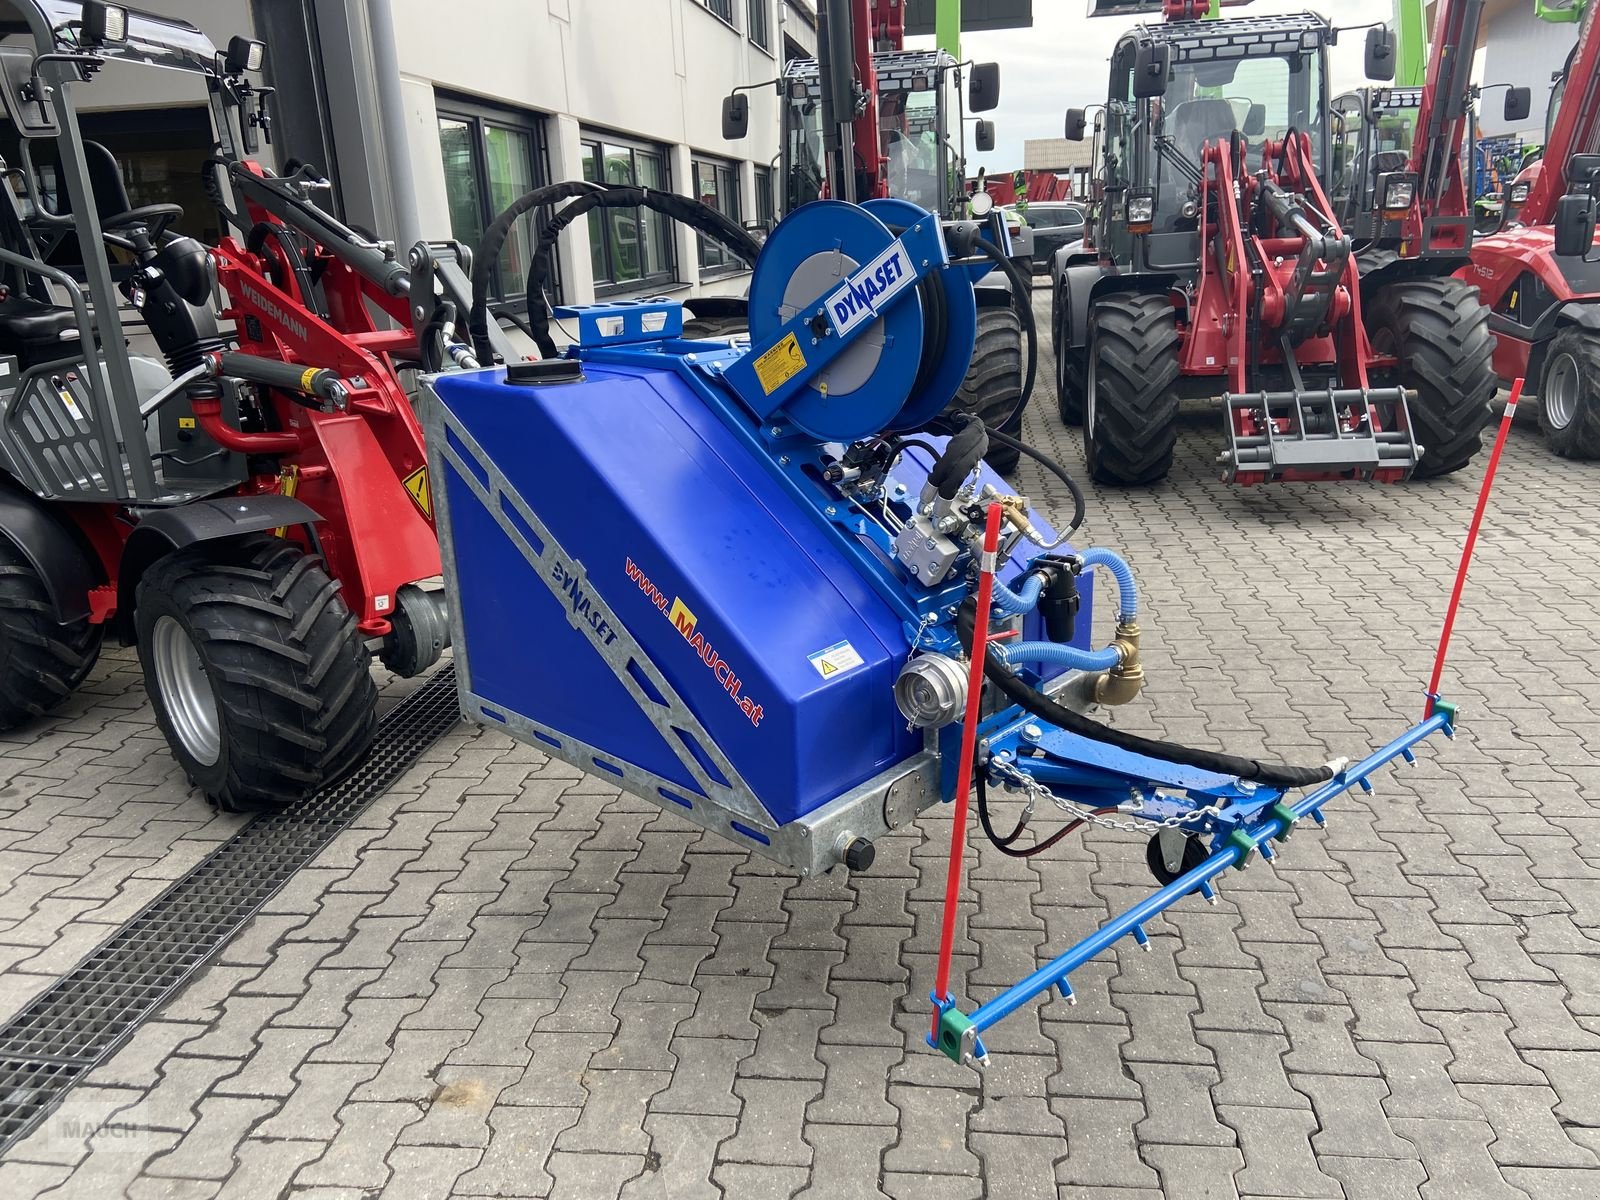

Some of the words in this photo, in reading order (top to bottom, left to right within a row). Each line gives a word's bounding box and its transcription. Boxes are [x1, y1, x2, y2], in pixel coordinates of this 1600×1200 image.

[1573, 0, 1600, 65] WEIDEM
[833, 252, 903, 325] DYNASET
[1473, 263, 1494, 280] T4512
[240, 279, 307, 342] WEIDEMANN
[552, 560, 618, 646] DYNASET
[625, 556, 764, 727] www.MAUCH.at
